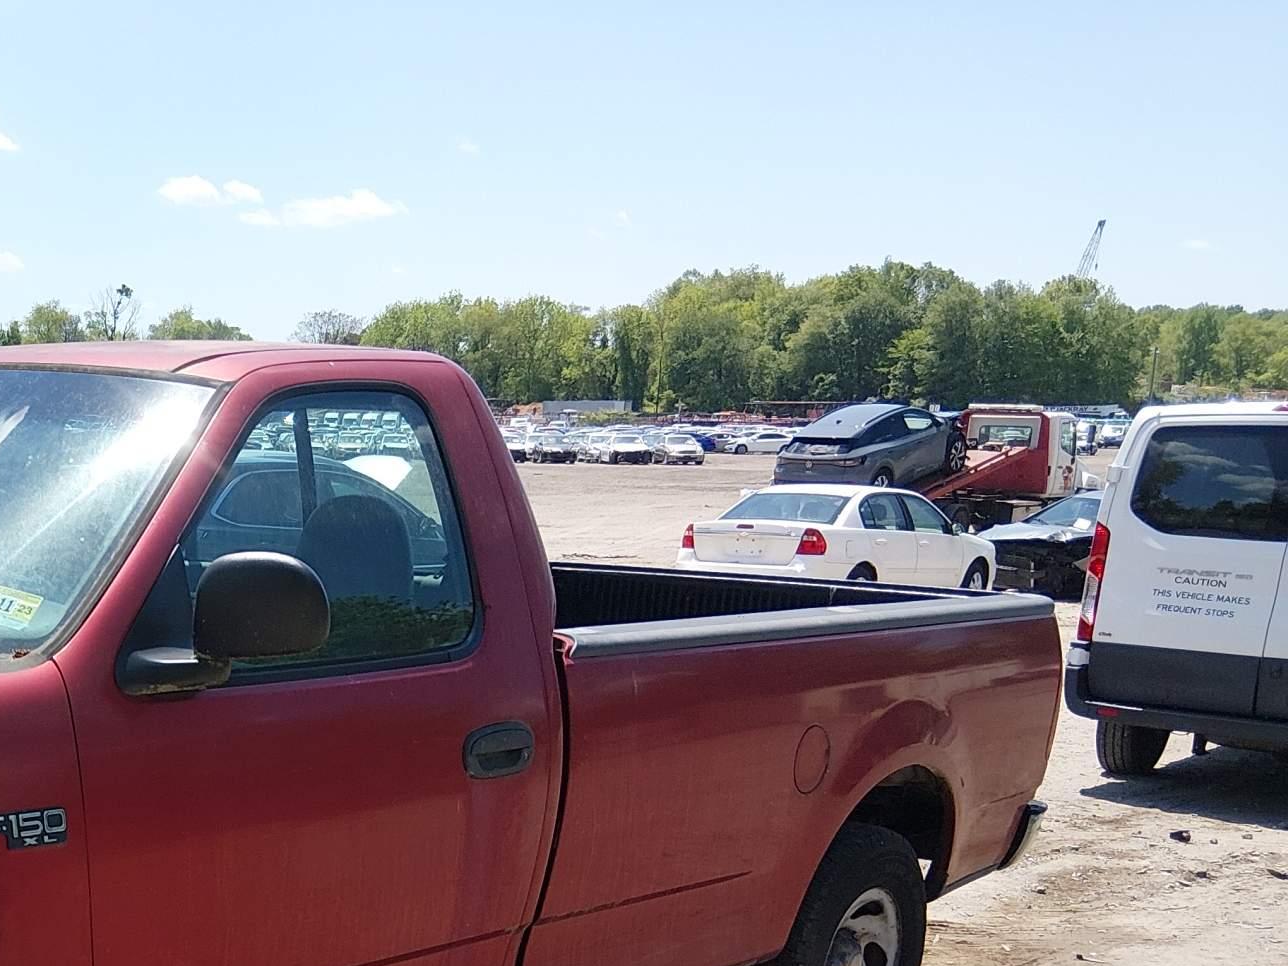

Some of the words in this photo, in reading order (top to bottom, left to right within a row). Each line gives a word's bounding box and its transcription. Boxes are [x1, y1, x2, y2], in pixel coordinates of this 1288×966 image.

[1156, 567, 1232, 577] TRANSIT
[1174, 576, 1227, 588] CAUTION
[1152, 588, 1172, 597] THIS
[1175, 591, 1214, 601] VEHICLE
[1216, 595, 1251, 605] MAKES
[17, 604, 33, 615] 23
[1156, 604, 1202, 614] FREQUENT
[1204, 608, 1235, 618] STOPS
[23, 835, 57, 847] XL
